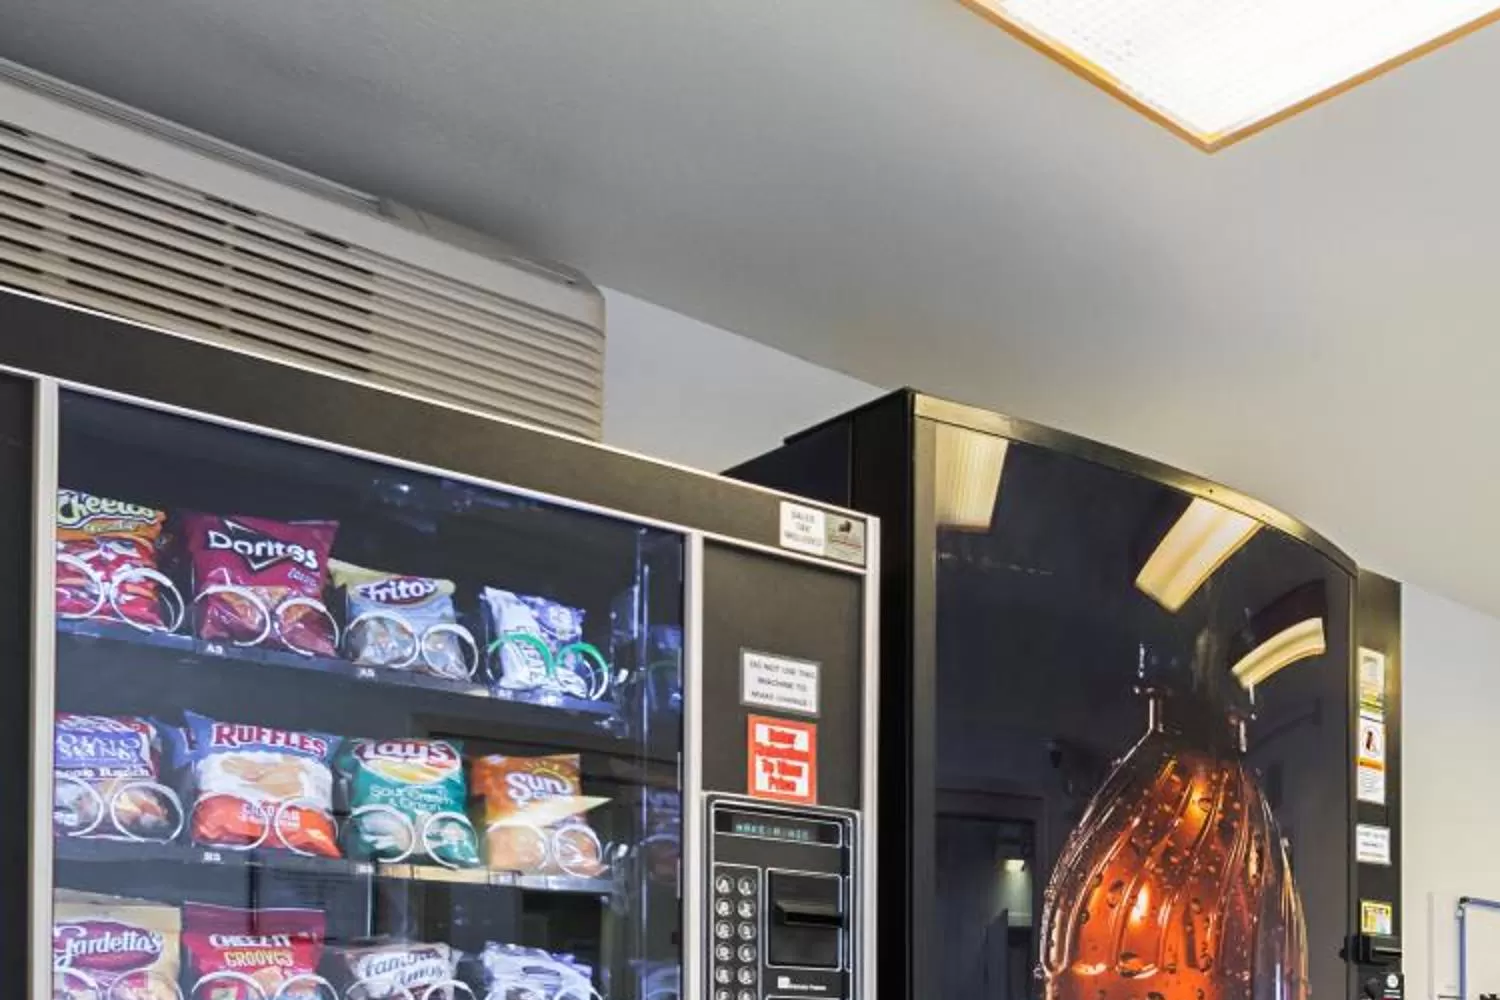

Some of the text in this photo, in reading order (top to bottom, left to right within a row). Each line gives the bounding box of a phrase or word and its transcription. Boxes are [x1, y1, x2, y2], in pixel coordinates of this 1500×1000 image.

[208, 529, 319, 570] Doritos
[357, 578, 438, 602] Fritos
[213, 723, 327, 757] RUFFLES
[505, 771, 573, 801] Sun
